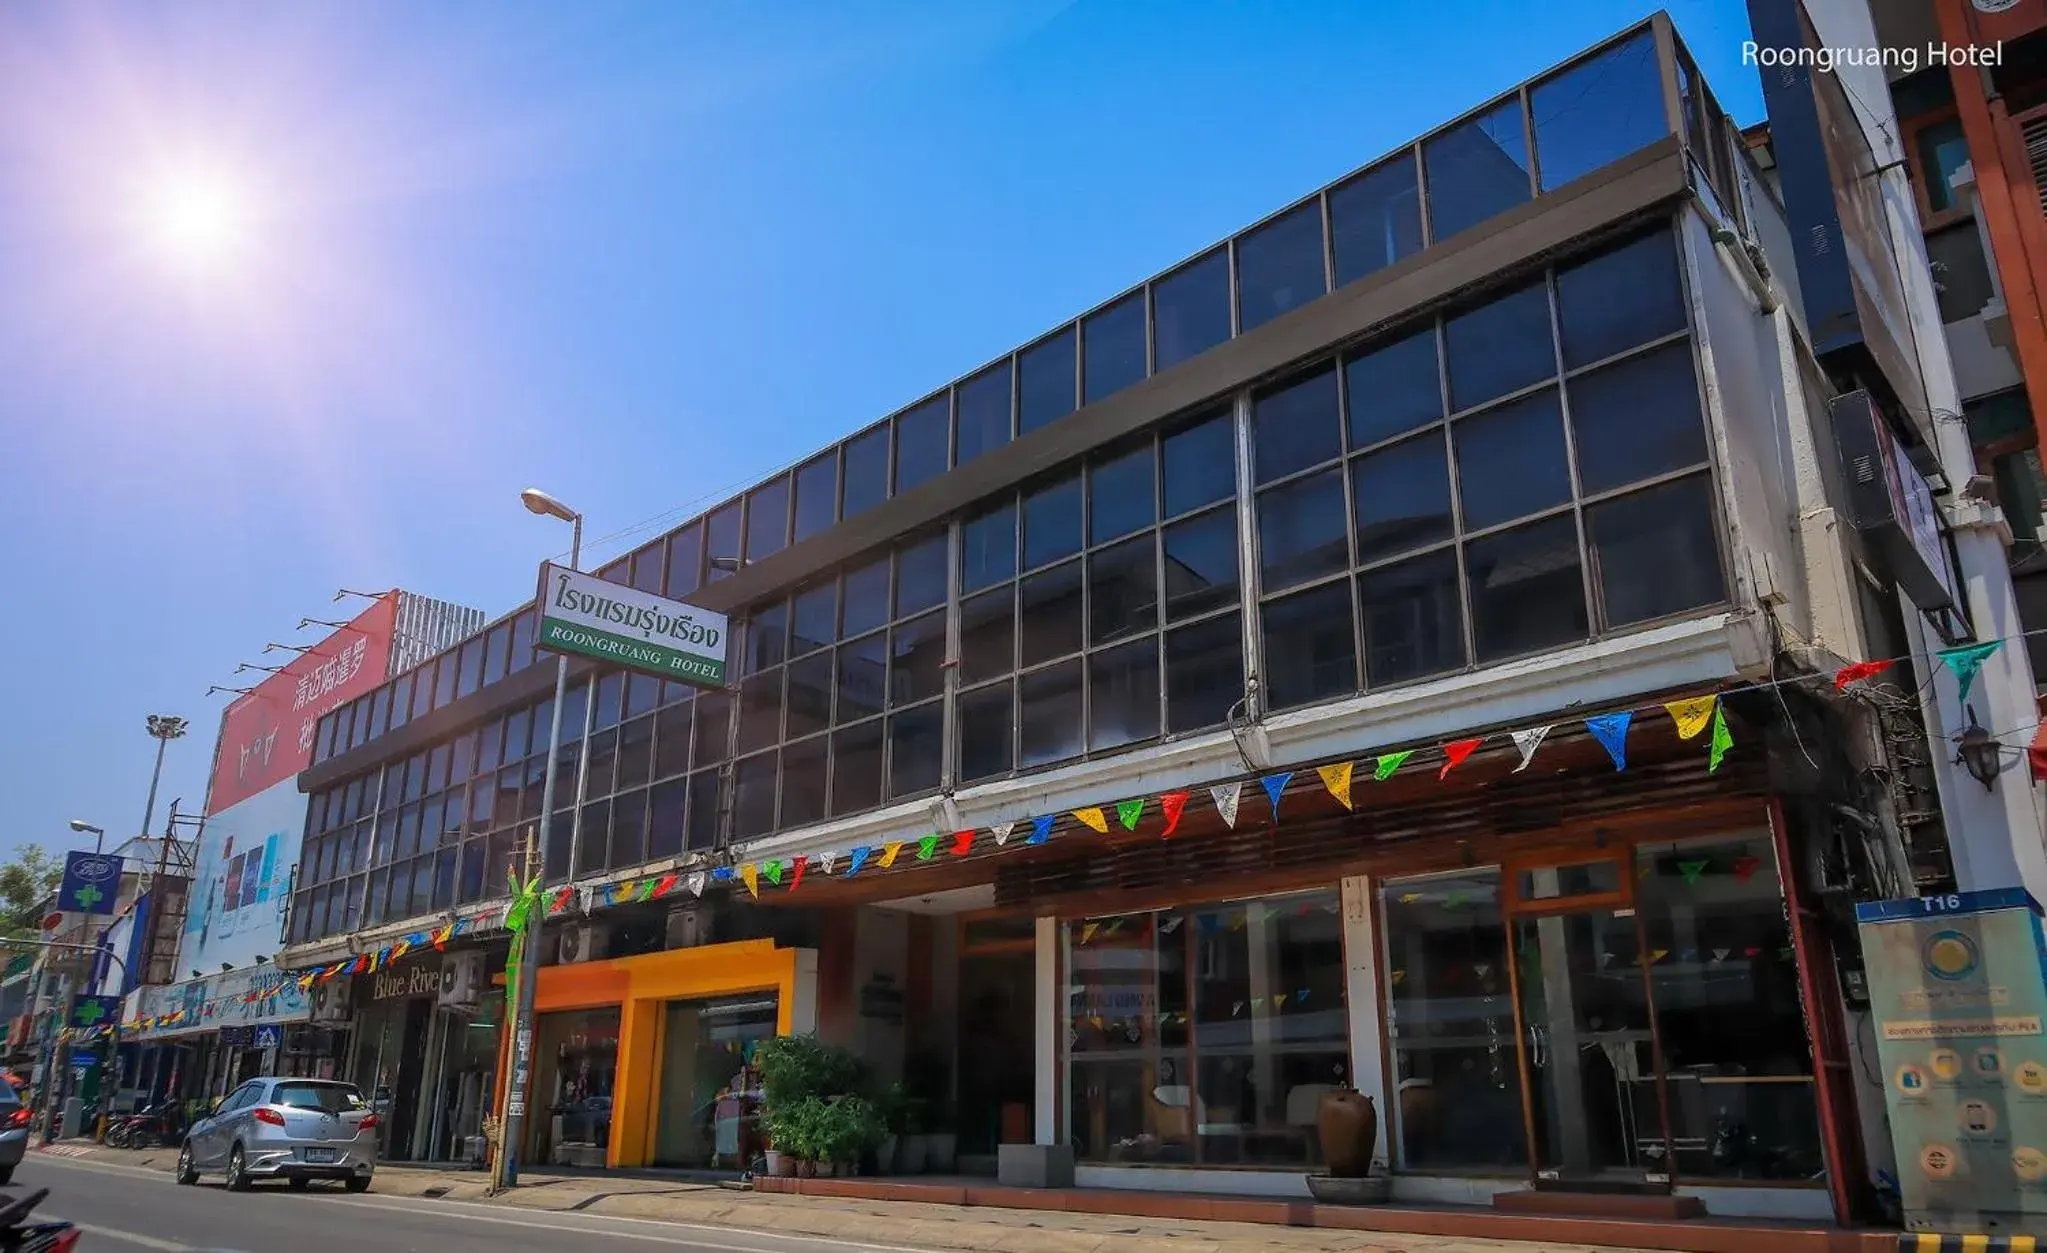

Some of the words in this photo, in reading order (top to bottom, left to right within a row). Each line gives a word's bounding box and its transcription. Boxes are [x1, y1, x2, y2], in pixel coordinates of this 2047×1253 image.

[555, 573, 719, 648] โรงแรมรุ่งเรือง
[550, 626, 661, 664] ROONGRUANG
[670, 656, 719, 678] HOTEL
[1921, 894, 1960, 911] T16
[374, 970, 405, 999] Blue
